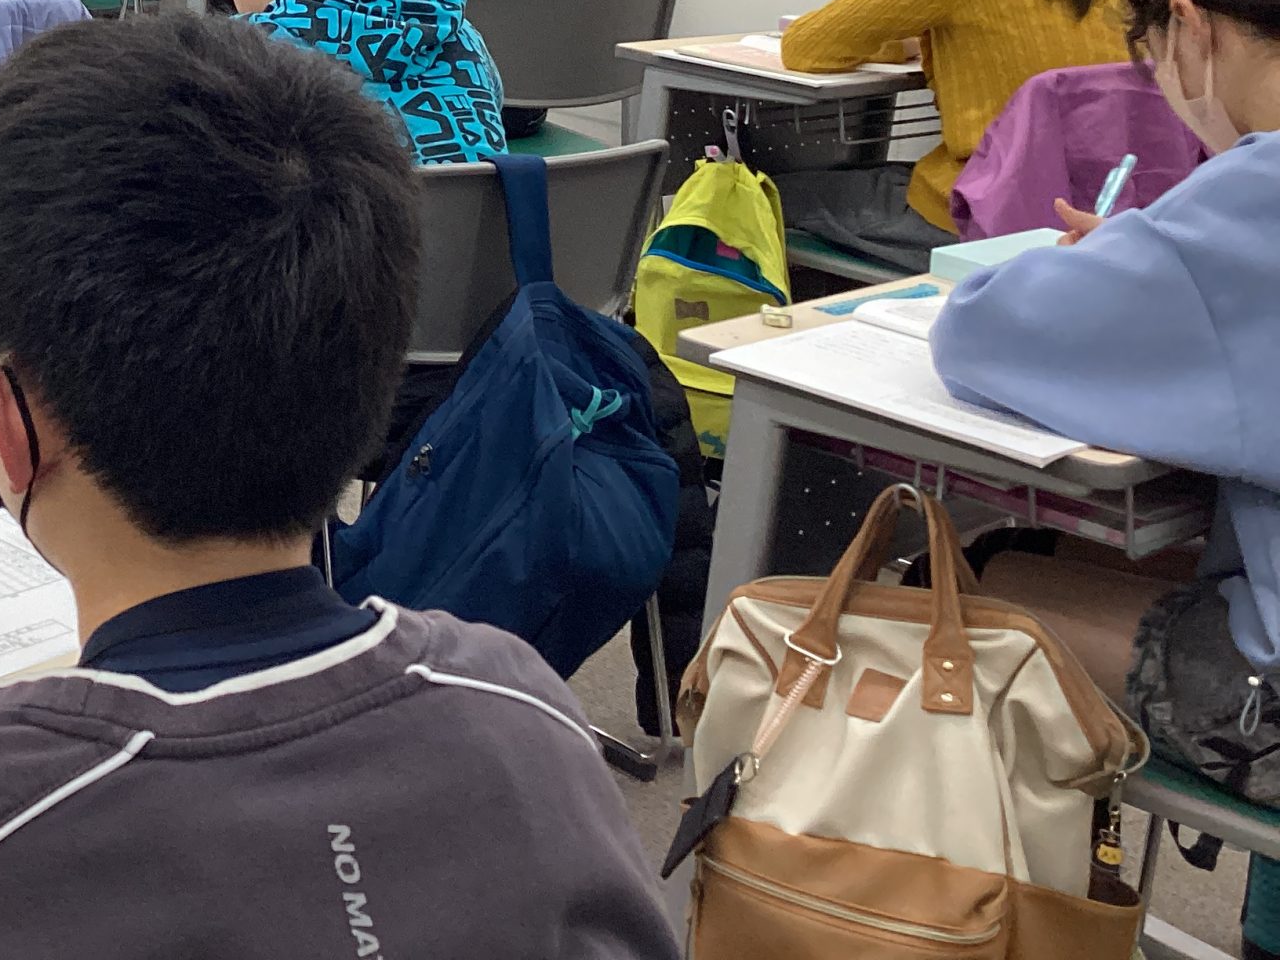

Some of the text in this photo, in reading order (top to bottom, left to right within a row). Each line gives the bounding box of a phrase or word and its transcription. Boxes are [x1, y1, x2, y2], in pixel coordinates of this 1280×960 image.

[441, 94, 481, 146] FILA
[327, 824, 384, 960] NO MA
